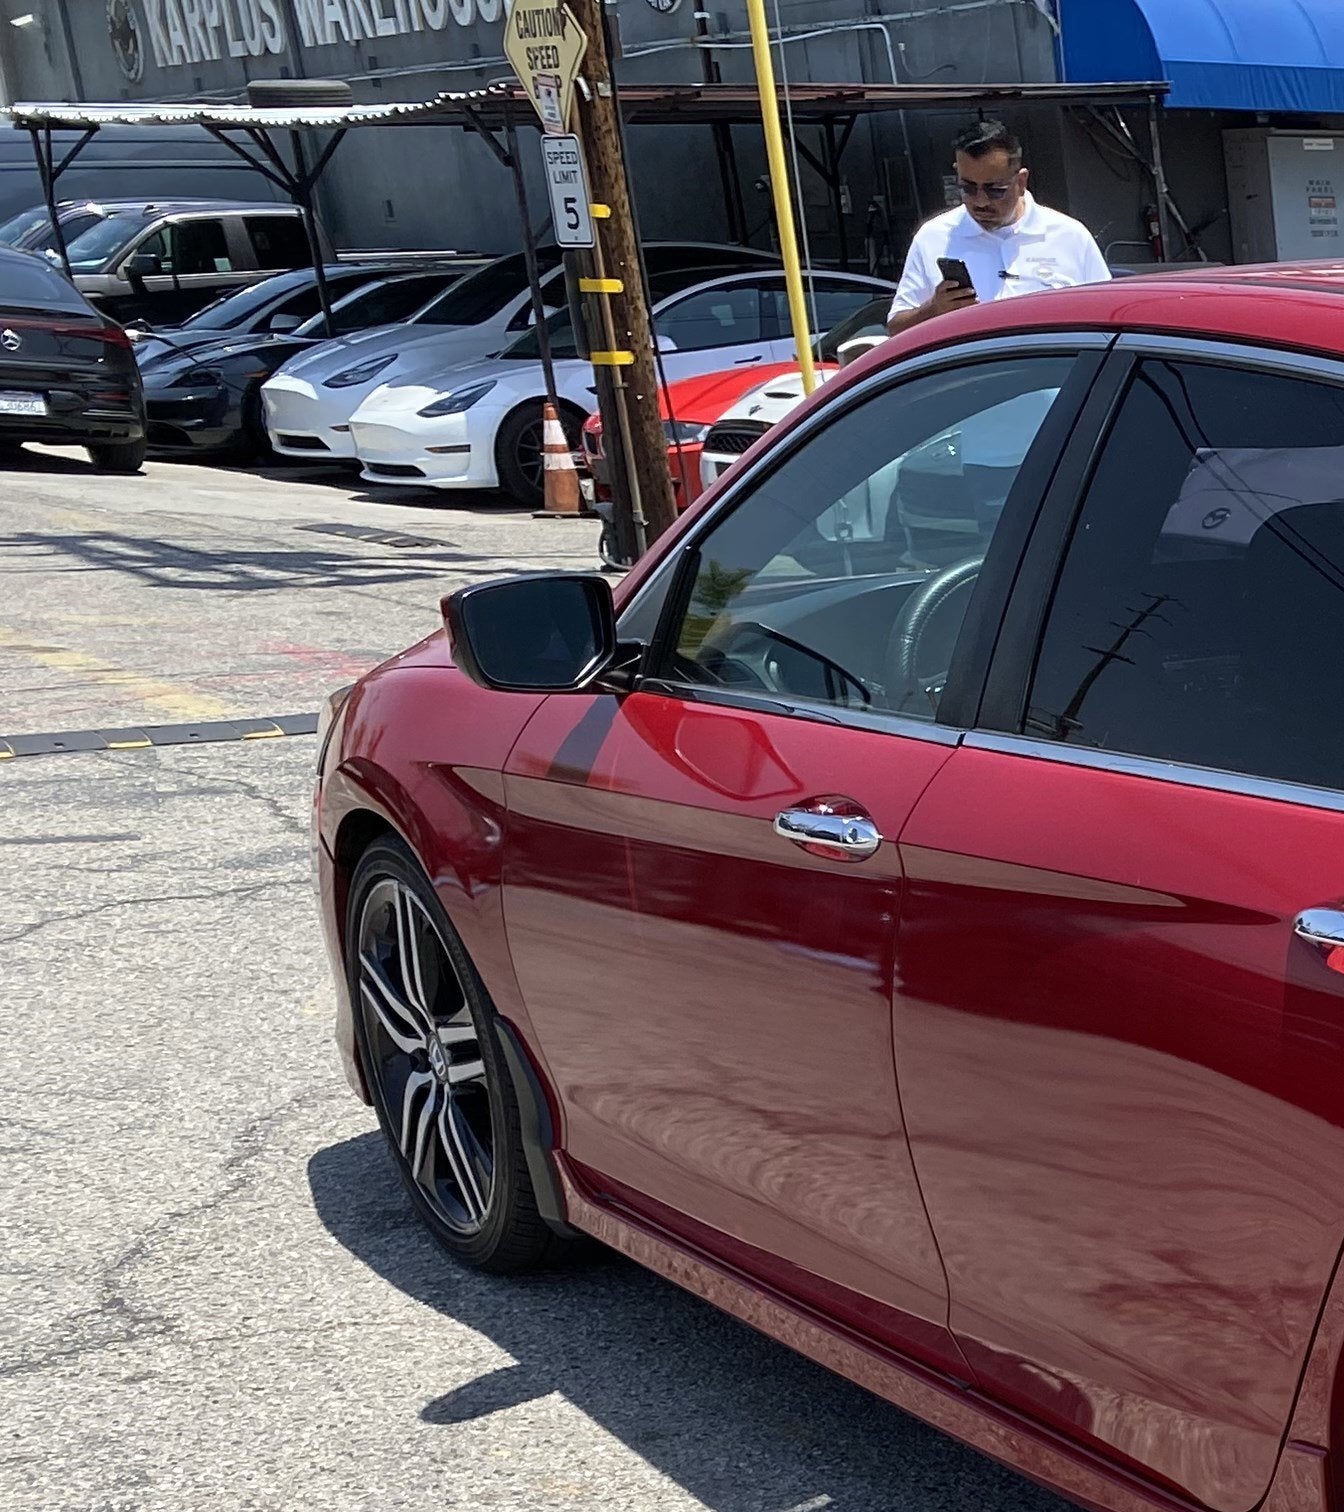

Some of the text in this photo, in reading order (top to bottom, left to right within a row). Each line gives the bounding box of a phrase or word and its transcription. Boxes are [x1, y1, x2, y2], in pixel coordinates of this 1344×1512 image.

[144, 0, 284, 68] KARPLUS
[515, 8, 564, 39] CAUTION
[526, 45, 560, 71] SPEED
[547, 151, 578, 165] SPEED
[553, 170, 578, 184] LIMIT
[564, 197, 580, 230] 5
